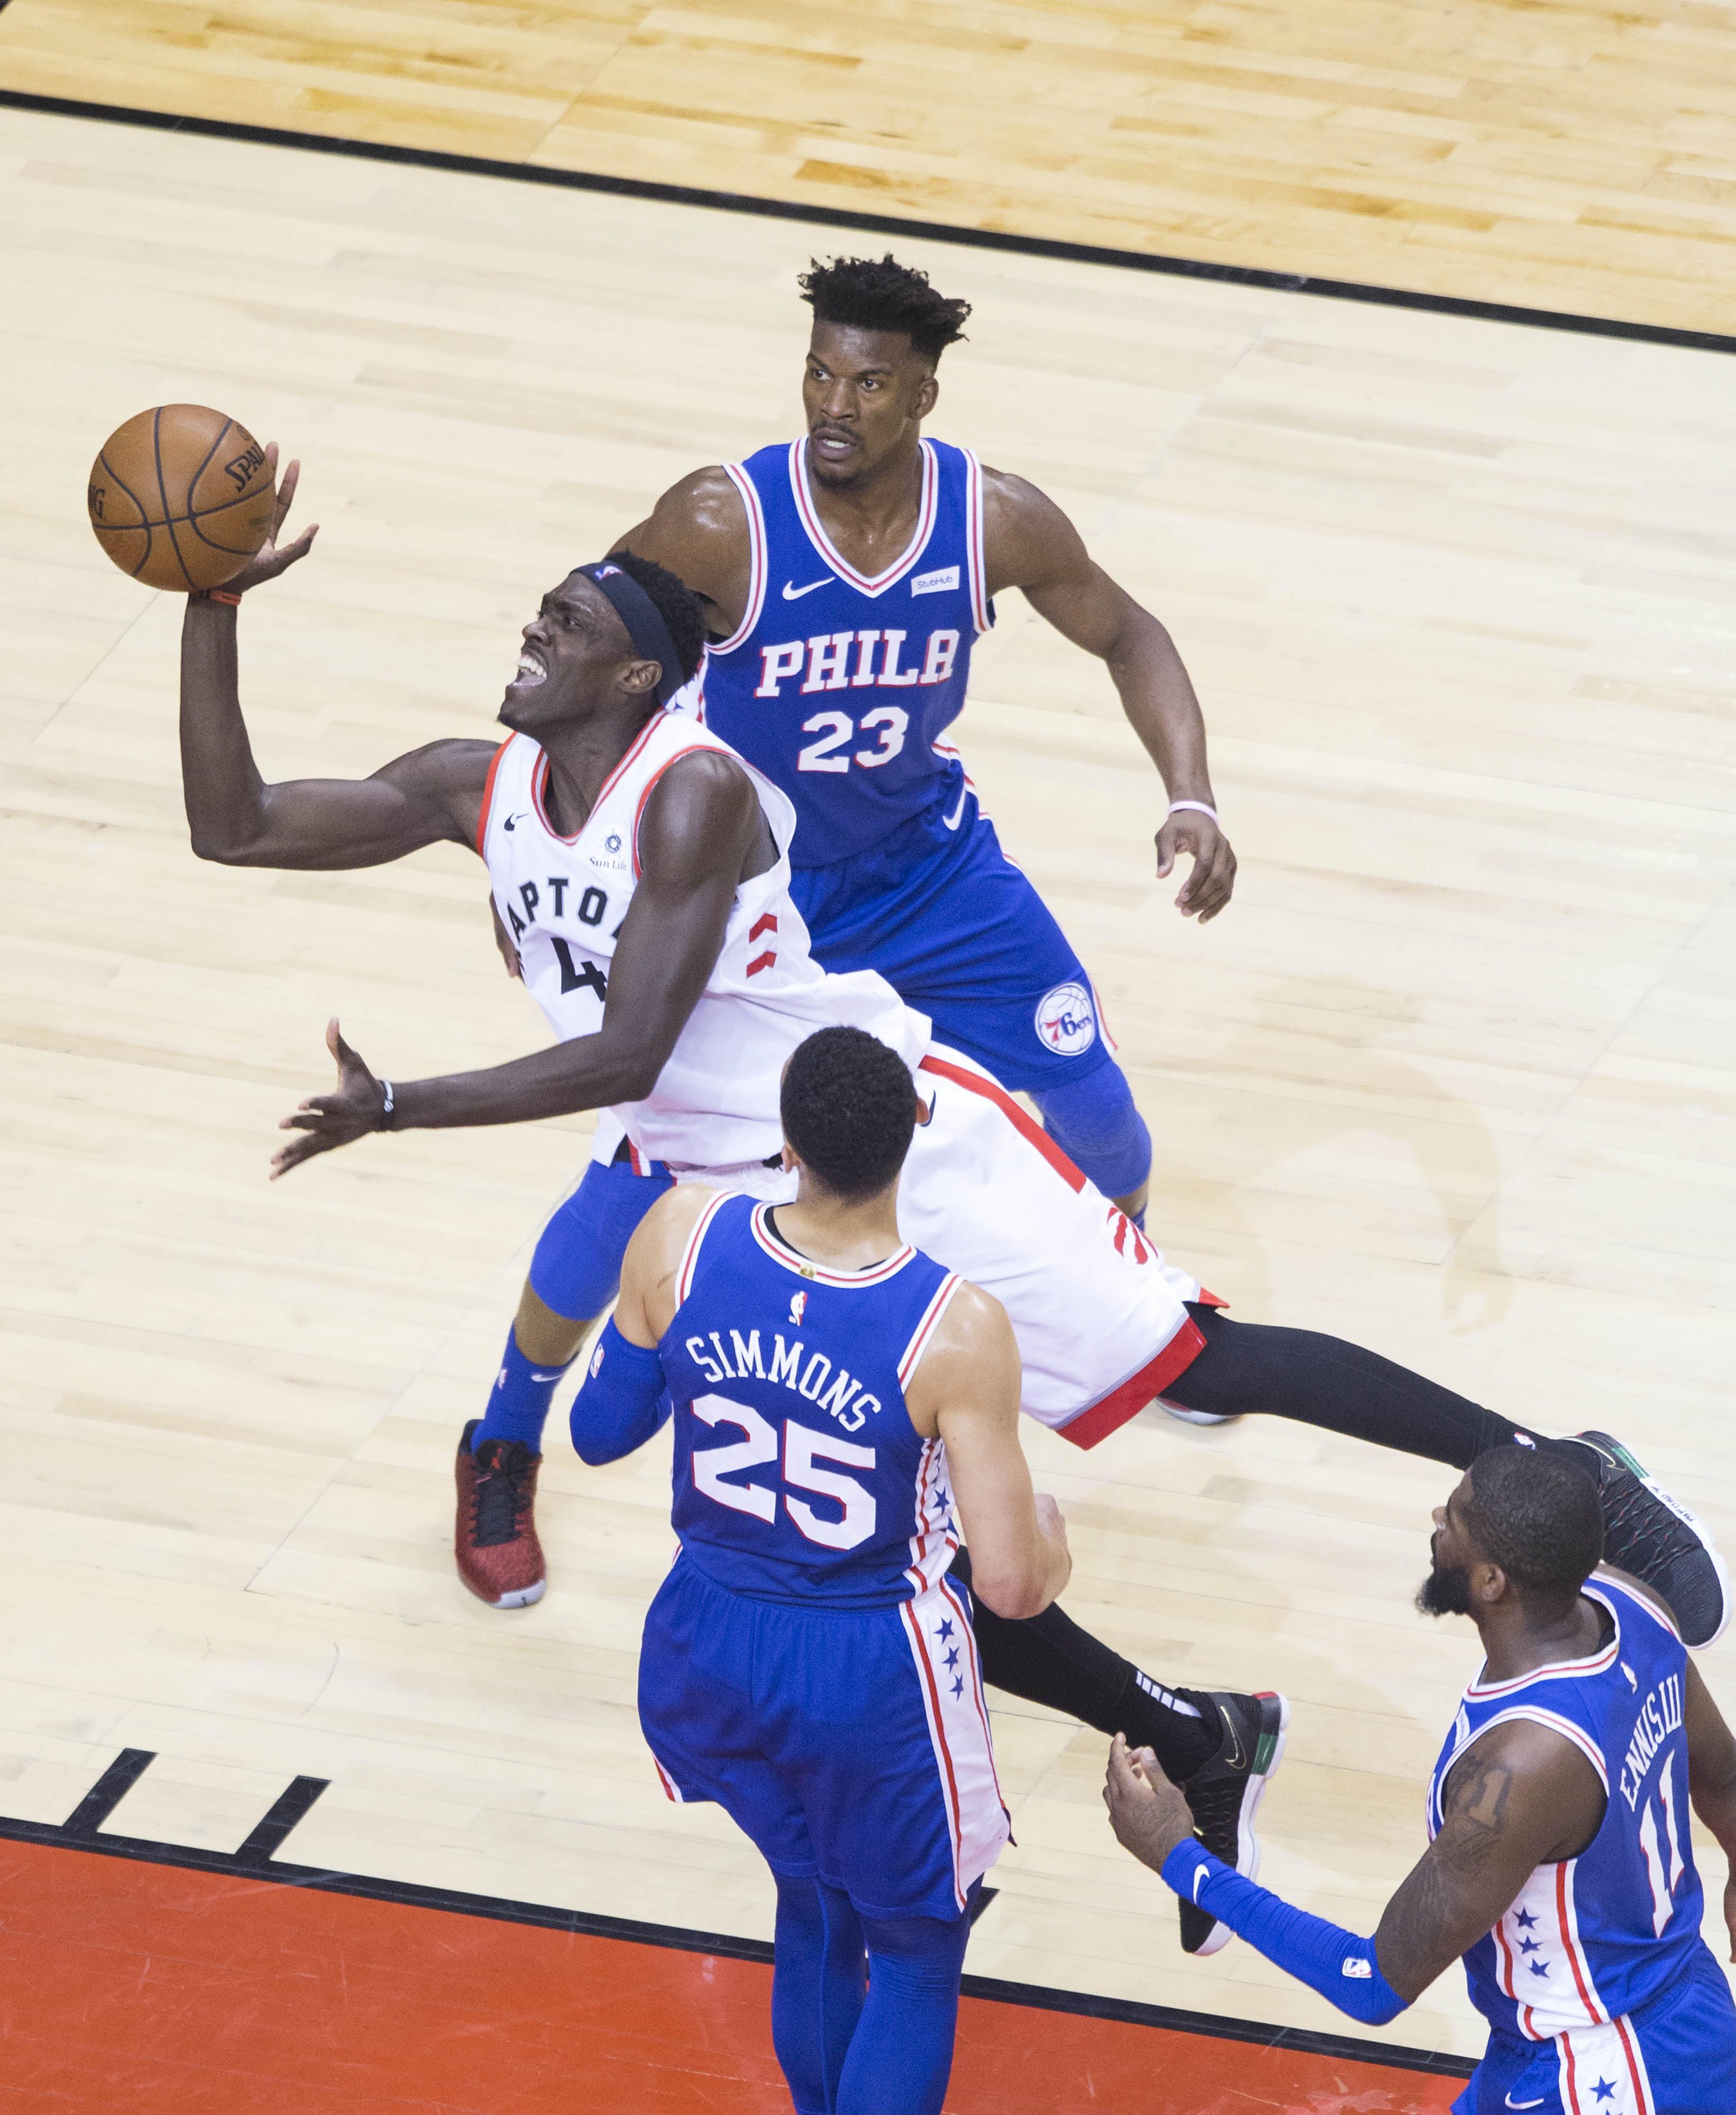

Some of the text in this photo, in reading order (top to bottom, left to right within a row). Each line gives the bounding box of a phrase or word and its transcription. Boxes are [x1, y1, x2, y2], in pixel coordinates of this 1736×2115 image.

[917, 575, 953, 589] StubHub
[753, 629, 960, 698] PHILA
[796, 706, 909, 773] 23
[590, 857, 627, 871] Sun Life
[550, 937, 608, 1002] 4
[686, 1330, 881, 1432] SIMMONS
[691, 1393, 876, 1550] 25
[1620, 1691, 1665, 1812] ENNIS
[1639, 1750, 1685, 1939] 11
